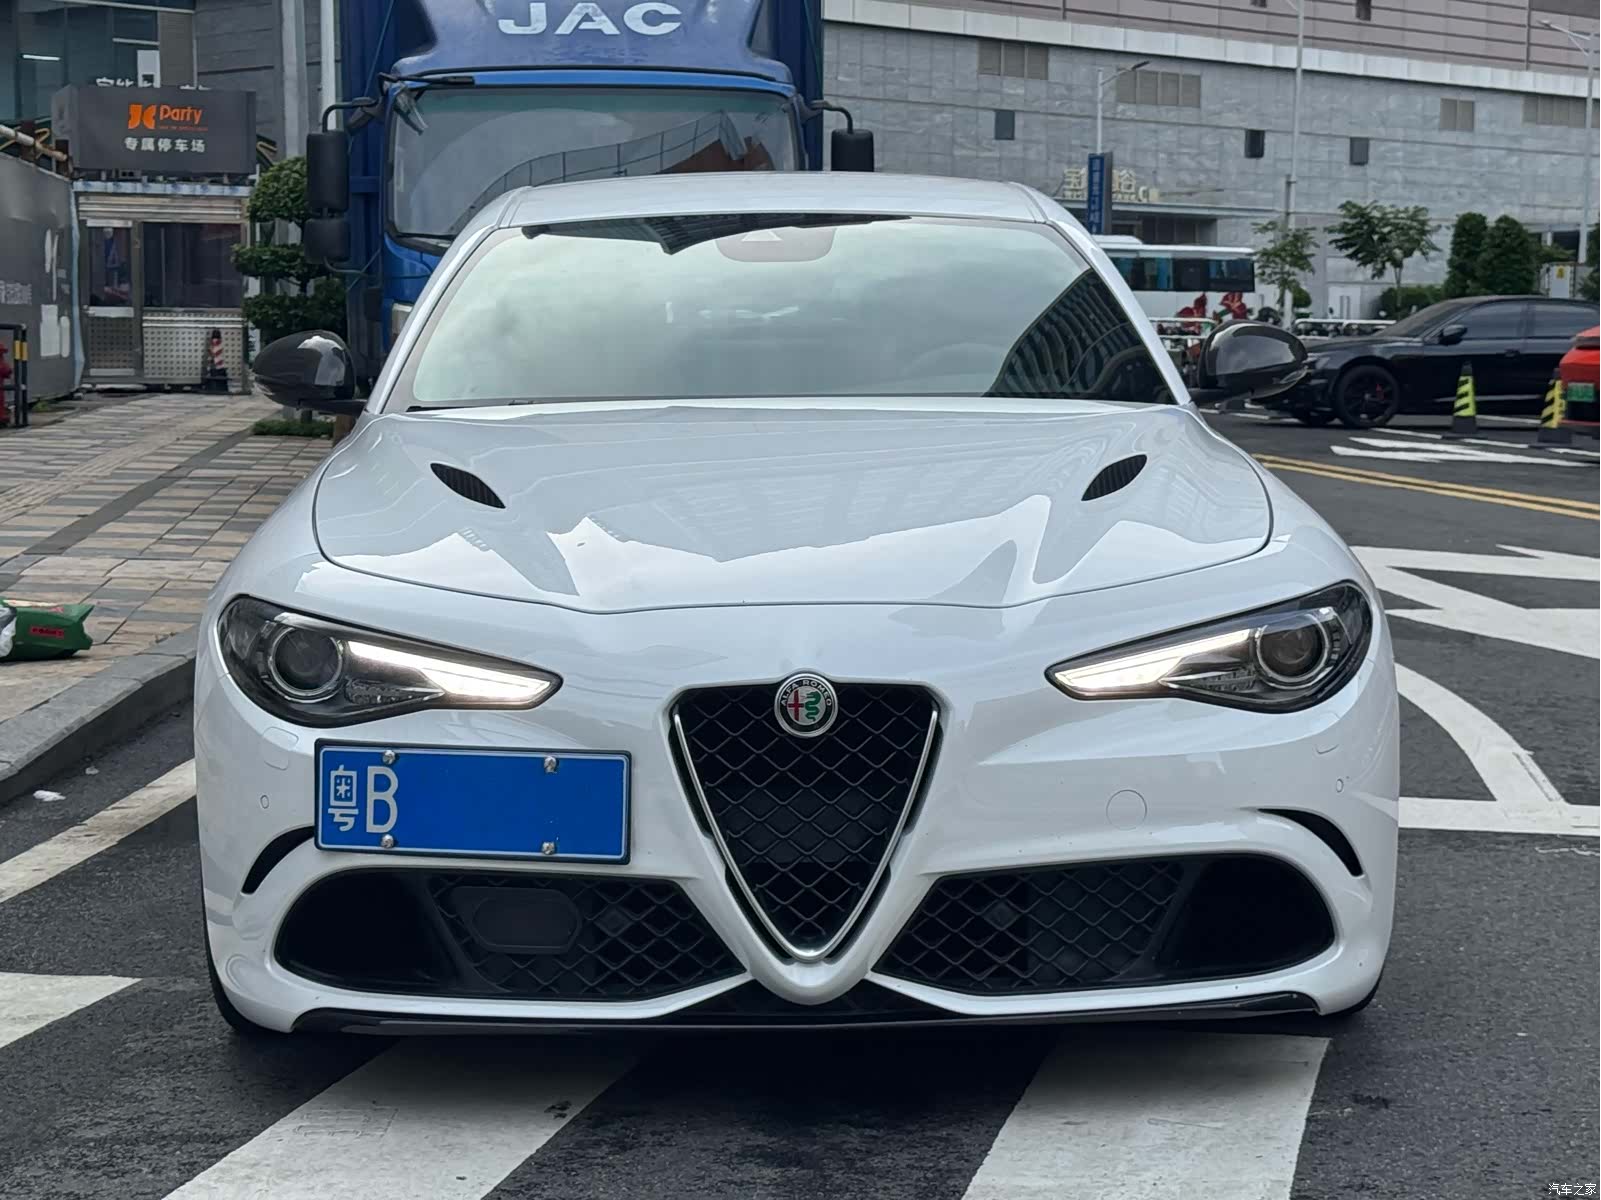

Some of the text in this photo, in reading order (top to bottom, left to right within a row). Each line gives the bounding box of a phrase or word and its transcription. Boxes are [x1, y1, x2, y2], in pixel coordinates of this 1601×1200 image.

[497, 2, 682, 35] JAC
[159, 104, 203, 125] Party
[124, 137, 205, 153] 专属停车场
[780, 679, 832, 707] ALFA ROMEO
[327, 764, 399, 833] 粤B
